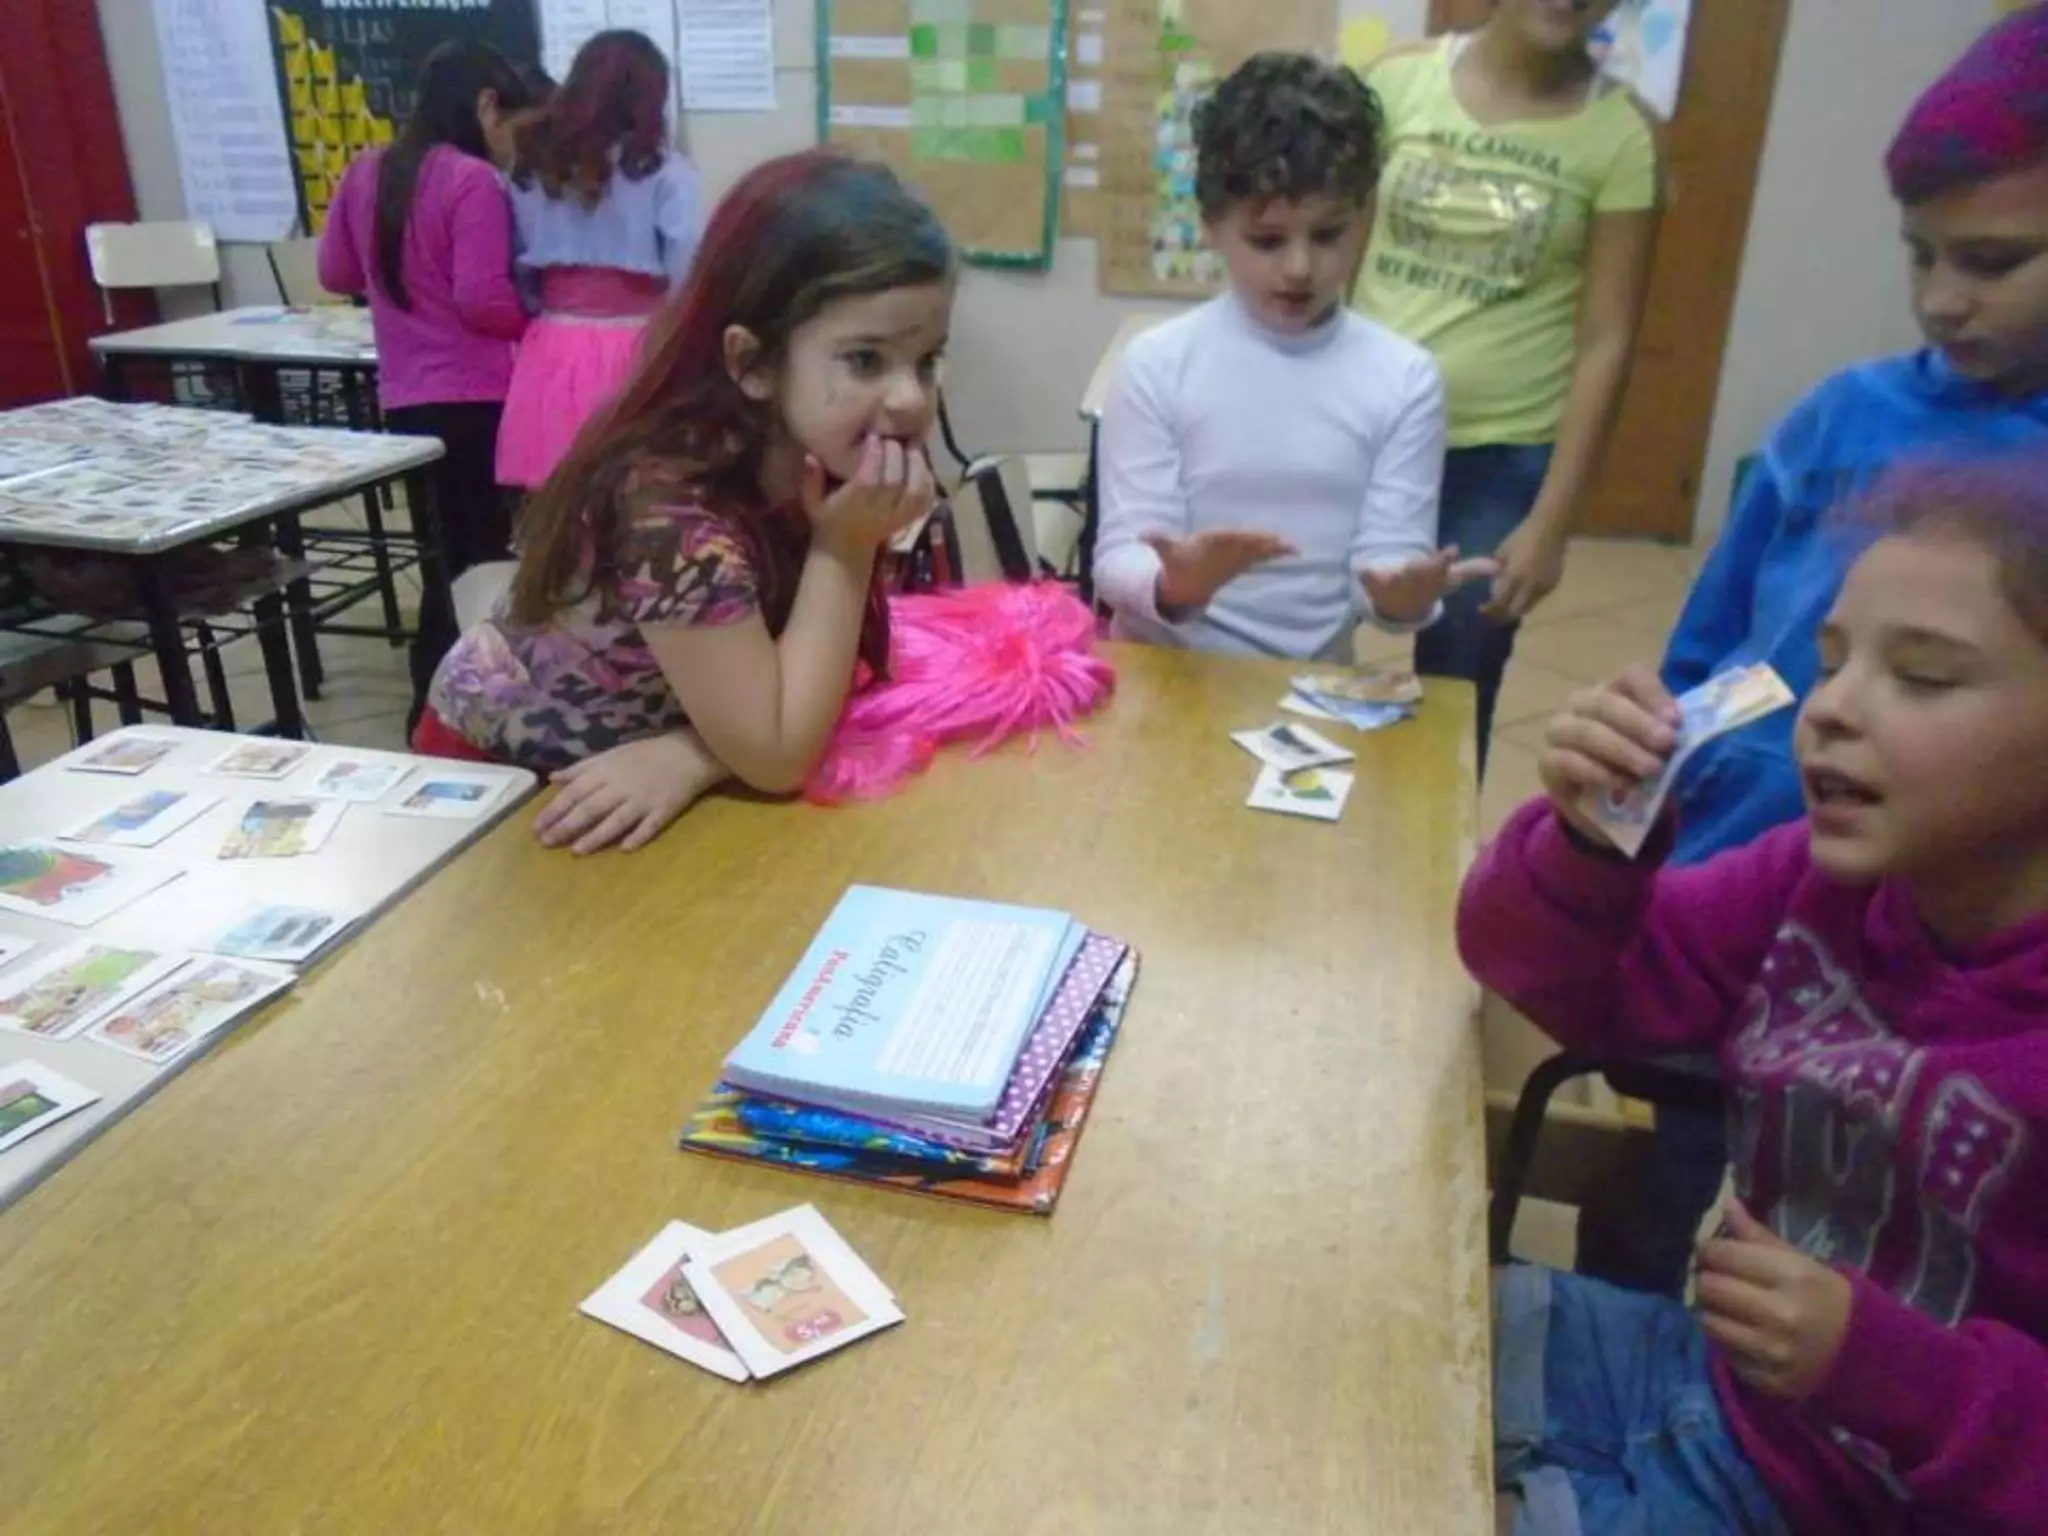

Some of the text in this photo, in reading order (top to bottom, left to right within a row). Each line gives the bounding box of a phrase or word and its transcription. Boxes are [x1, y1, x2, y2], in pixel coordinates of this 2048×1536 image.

[1465, 131, 1561, 178] CAMERA
[1376, 252, 1403, 276] MY
[832, 930, 927, 1042] Caligrafia
